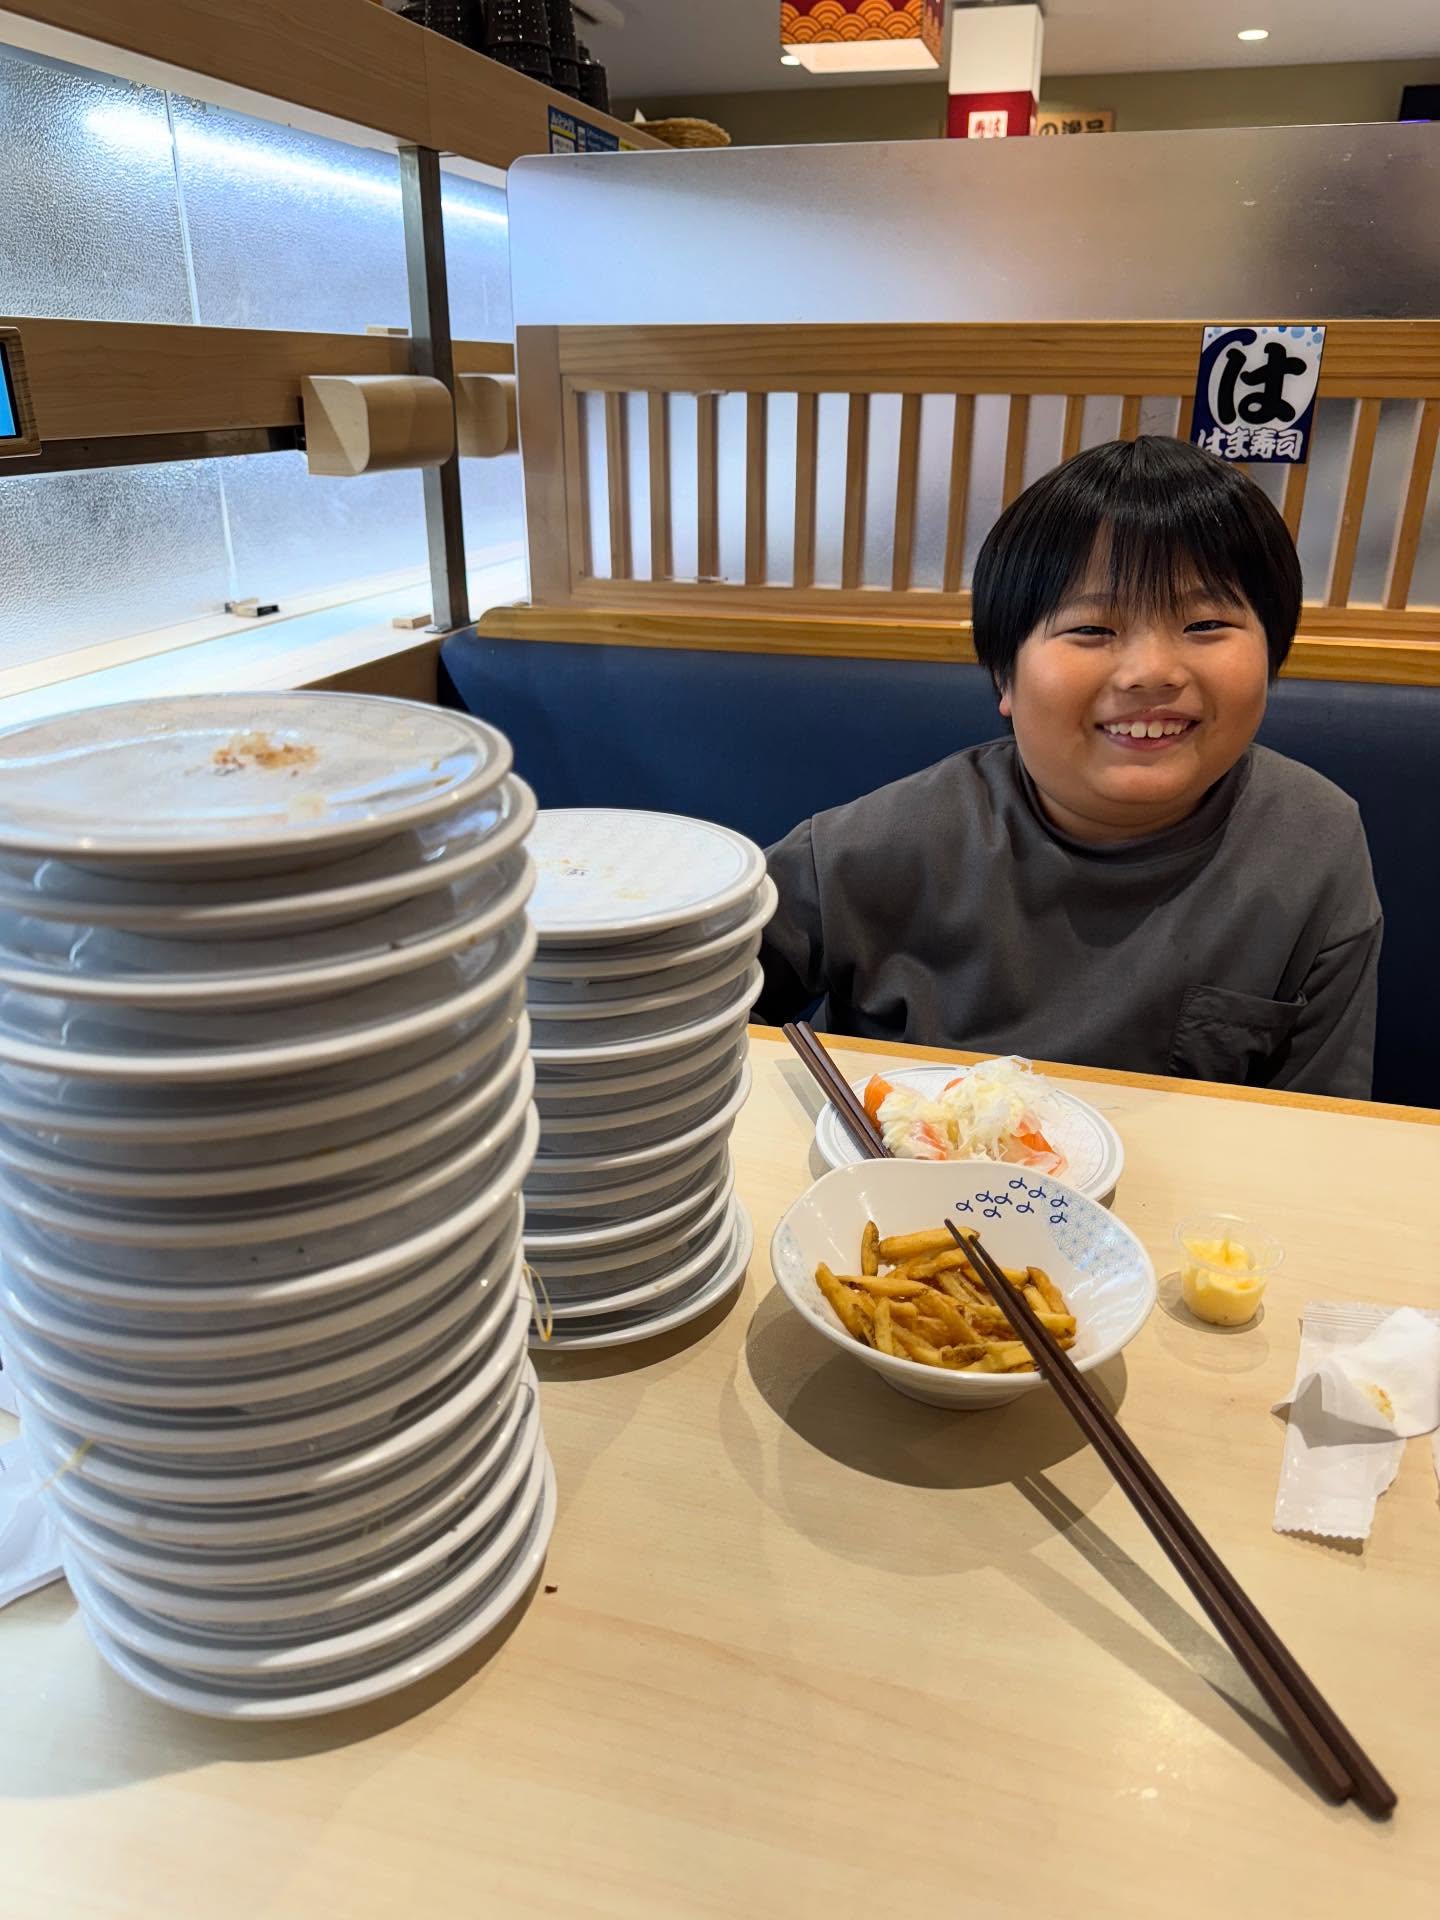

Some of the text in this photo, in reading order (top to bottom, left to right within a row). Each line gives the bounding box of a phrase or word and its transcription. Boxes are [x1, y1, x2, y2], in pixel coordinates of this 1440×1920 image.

[1217, 342, 1308, 425] は
[1197, 427, 1304, 460] はま寿司
